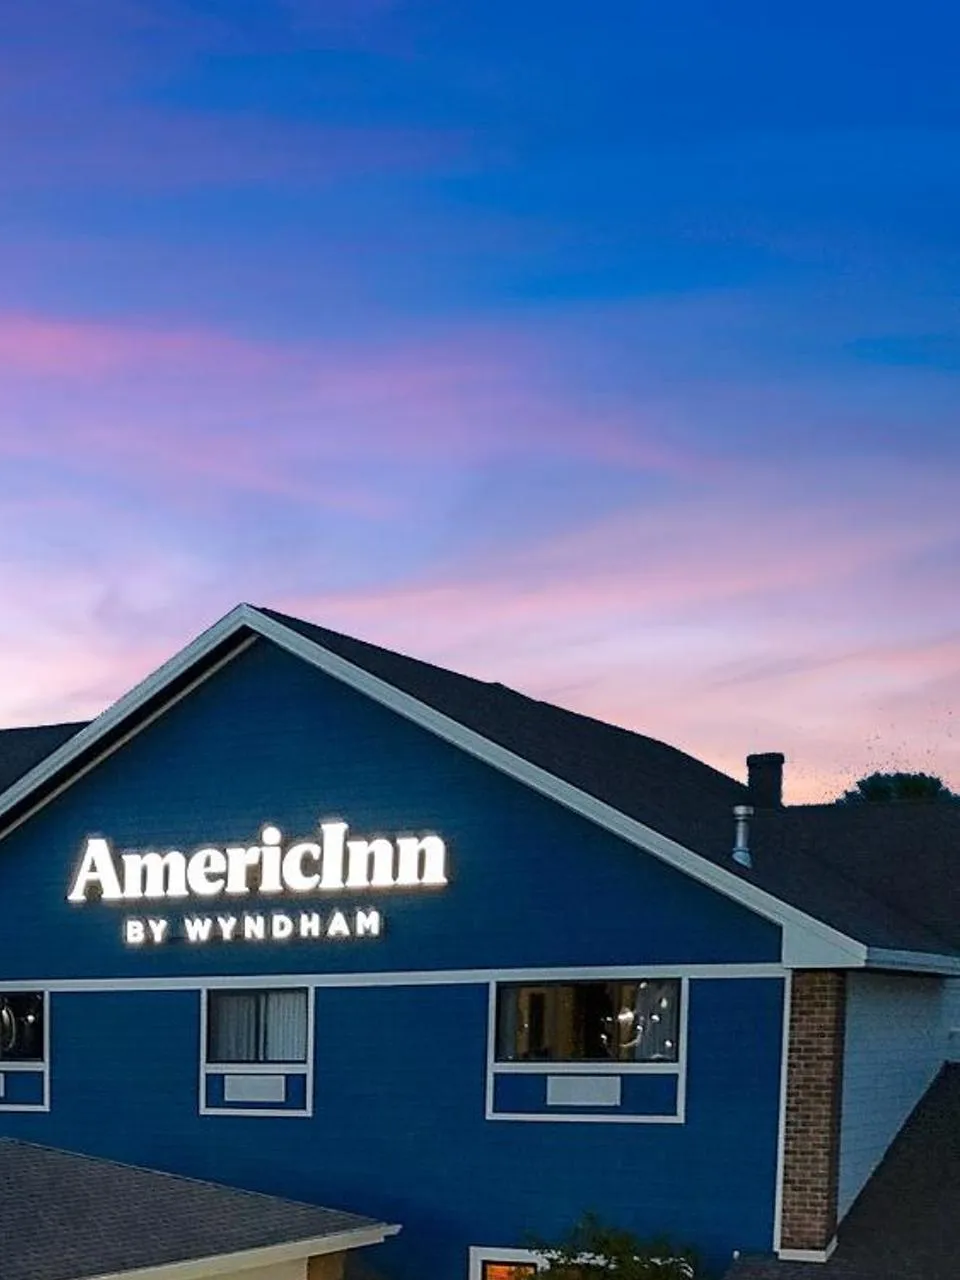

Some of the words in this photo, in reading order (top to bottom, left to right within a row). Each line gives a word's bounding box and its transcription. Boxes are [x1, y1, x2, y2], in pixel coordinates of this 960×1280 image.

[66, 821, 448, 901] AmericInn
[125, 919, 168, 944] BY
[184, 909, 381, 942] WYNDHAM
